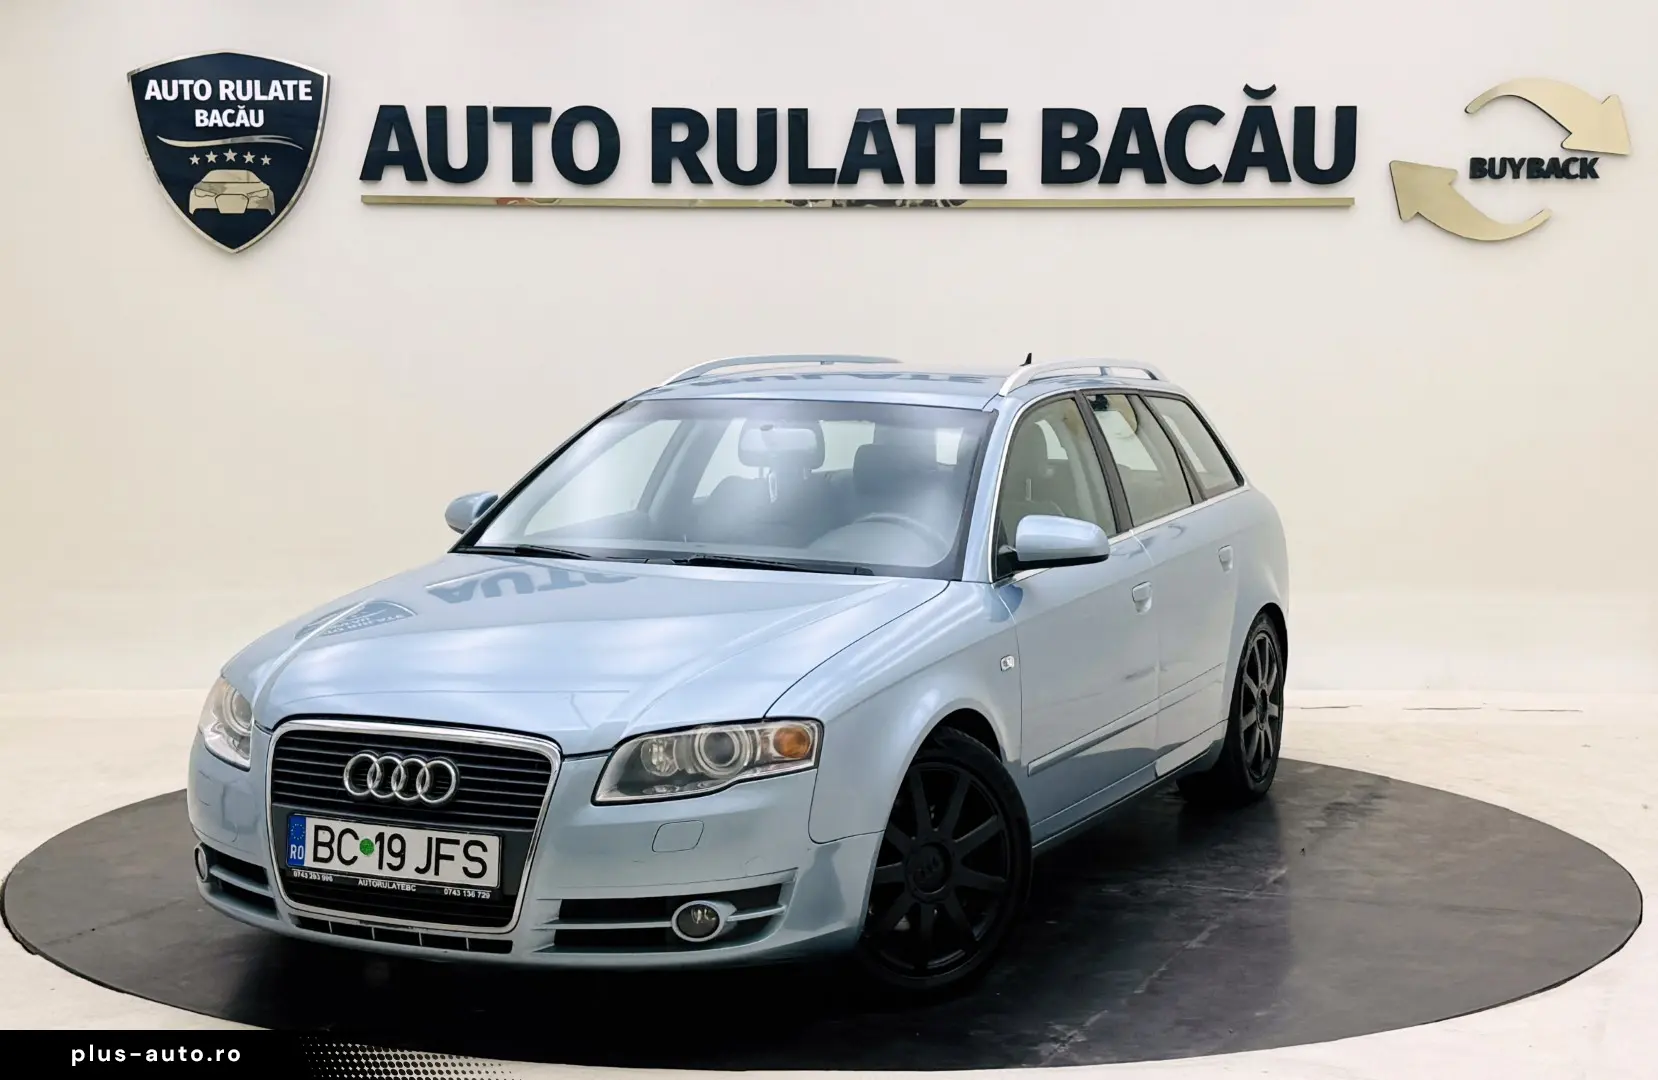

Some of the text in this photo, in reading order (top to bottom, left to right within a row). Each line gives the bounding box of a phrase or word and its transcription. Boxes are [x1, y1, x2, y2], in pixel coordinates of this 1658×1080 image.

[145, 79, 313, 101] AUTO RULATE
[194, 105, 265, 128] BACĂU
[359, 83, 1358, 186] AUTO RULATE BACĂU
[1469, 156, 1600, 180] BUYBACK
[289, 844, 305, 861] RO
[312, 824, 489, 879] BC 19 JFS
[358, 878, 417, 892] AUTORULATEBC
[443, 888, 461, 897] 0743
[477, 891, 491, 900] 729
